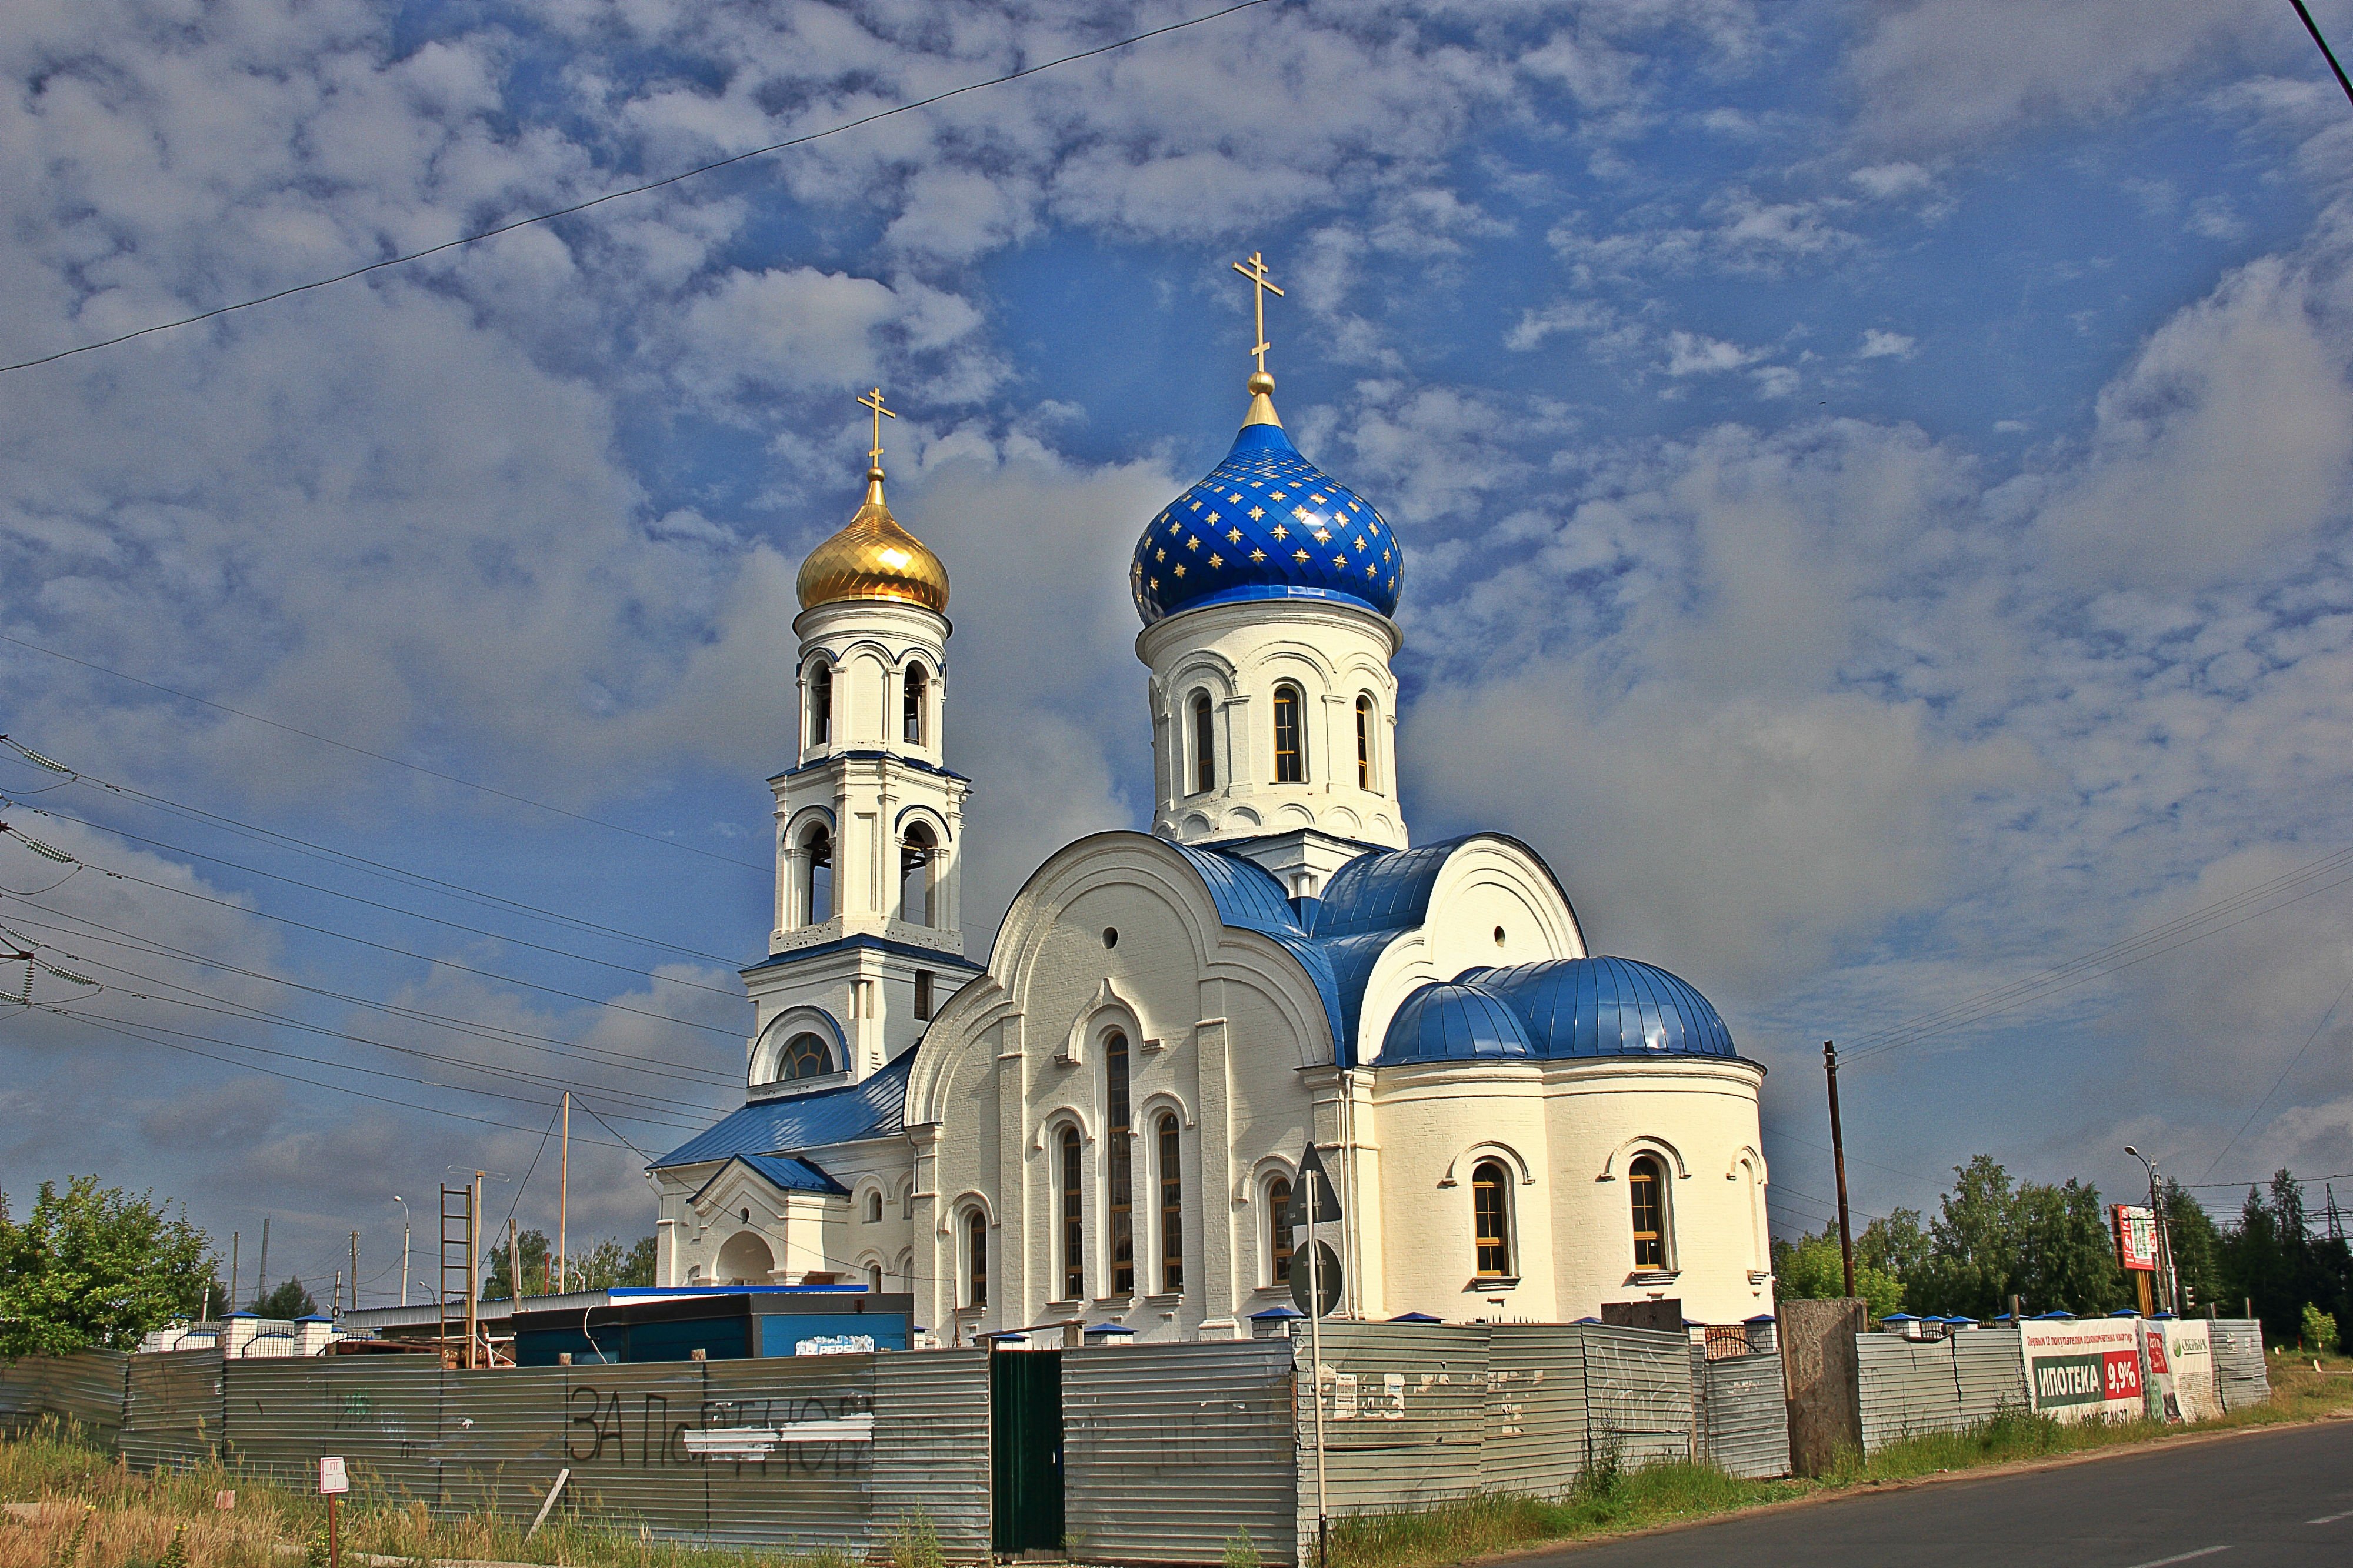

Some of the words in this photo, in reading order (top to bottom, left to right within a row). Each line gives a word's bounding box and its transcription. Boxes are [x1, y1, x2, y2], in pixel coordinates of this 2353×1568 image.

[819, 1345, 854, 1355] PEPSI
[2038, 1363, 2101, 1397] ИПОТЕКА
[2108, 1361, 2136, 1394] 9,9%
[569, 1386, 624, 1465] ЗА
